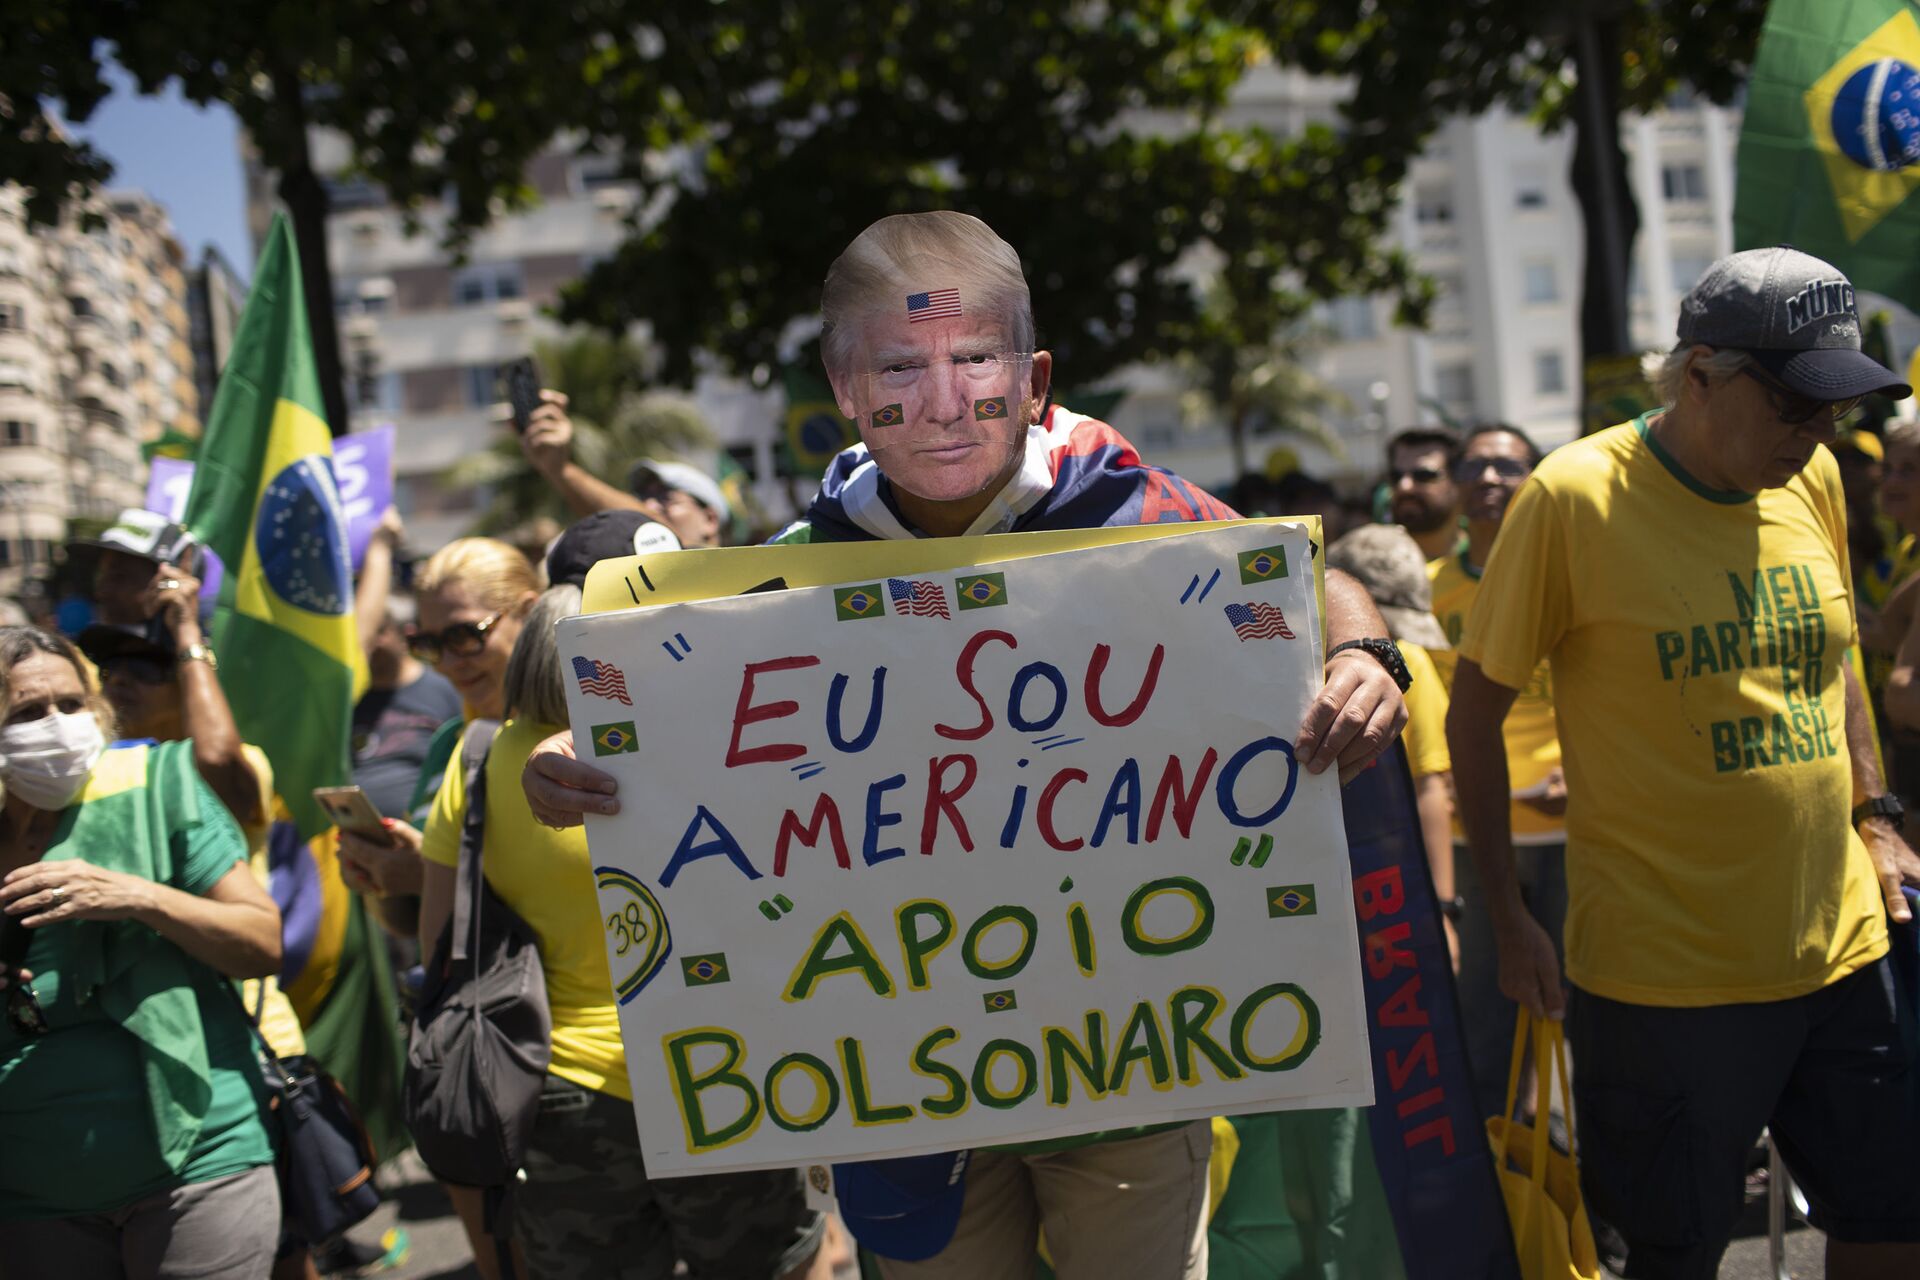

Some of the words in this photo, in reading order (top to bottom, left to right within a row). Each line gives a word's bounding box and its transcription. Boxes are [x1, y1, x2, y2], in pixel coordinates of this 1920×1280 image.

[1785, 278, 1855, 335] MÜNC
[1831, 323, 1857, 337] Origin
[1726, 564, 1821, 619] MEU
[1655, 612, 1826, 681] PARTIDO
[1711, 708, 1837, 774] BRASIL
[606, 901, 649, 957] 38
[663, 981, 1322, 1154] BOLSONARO
